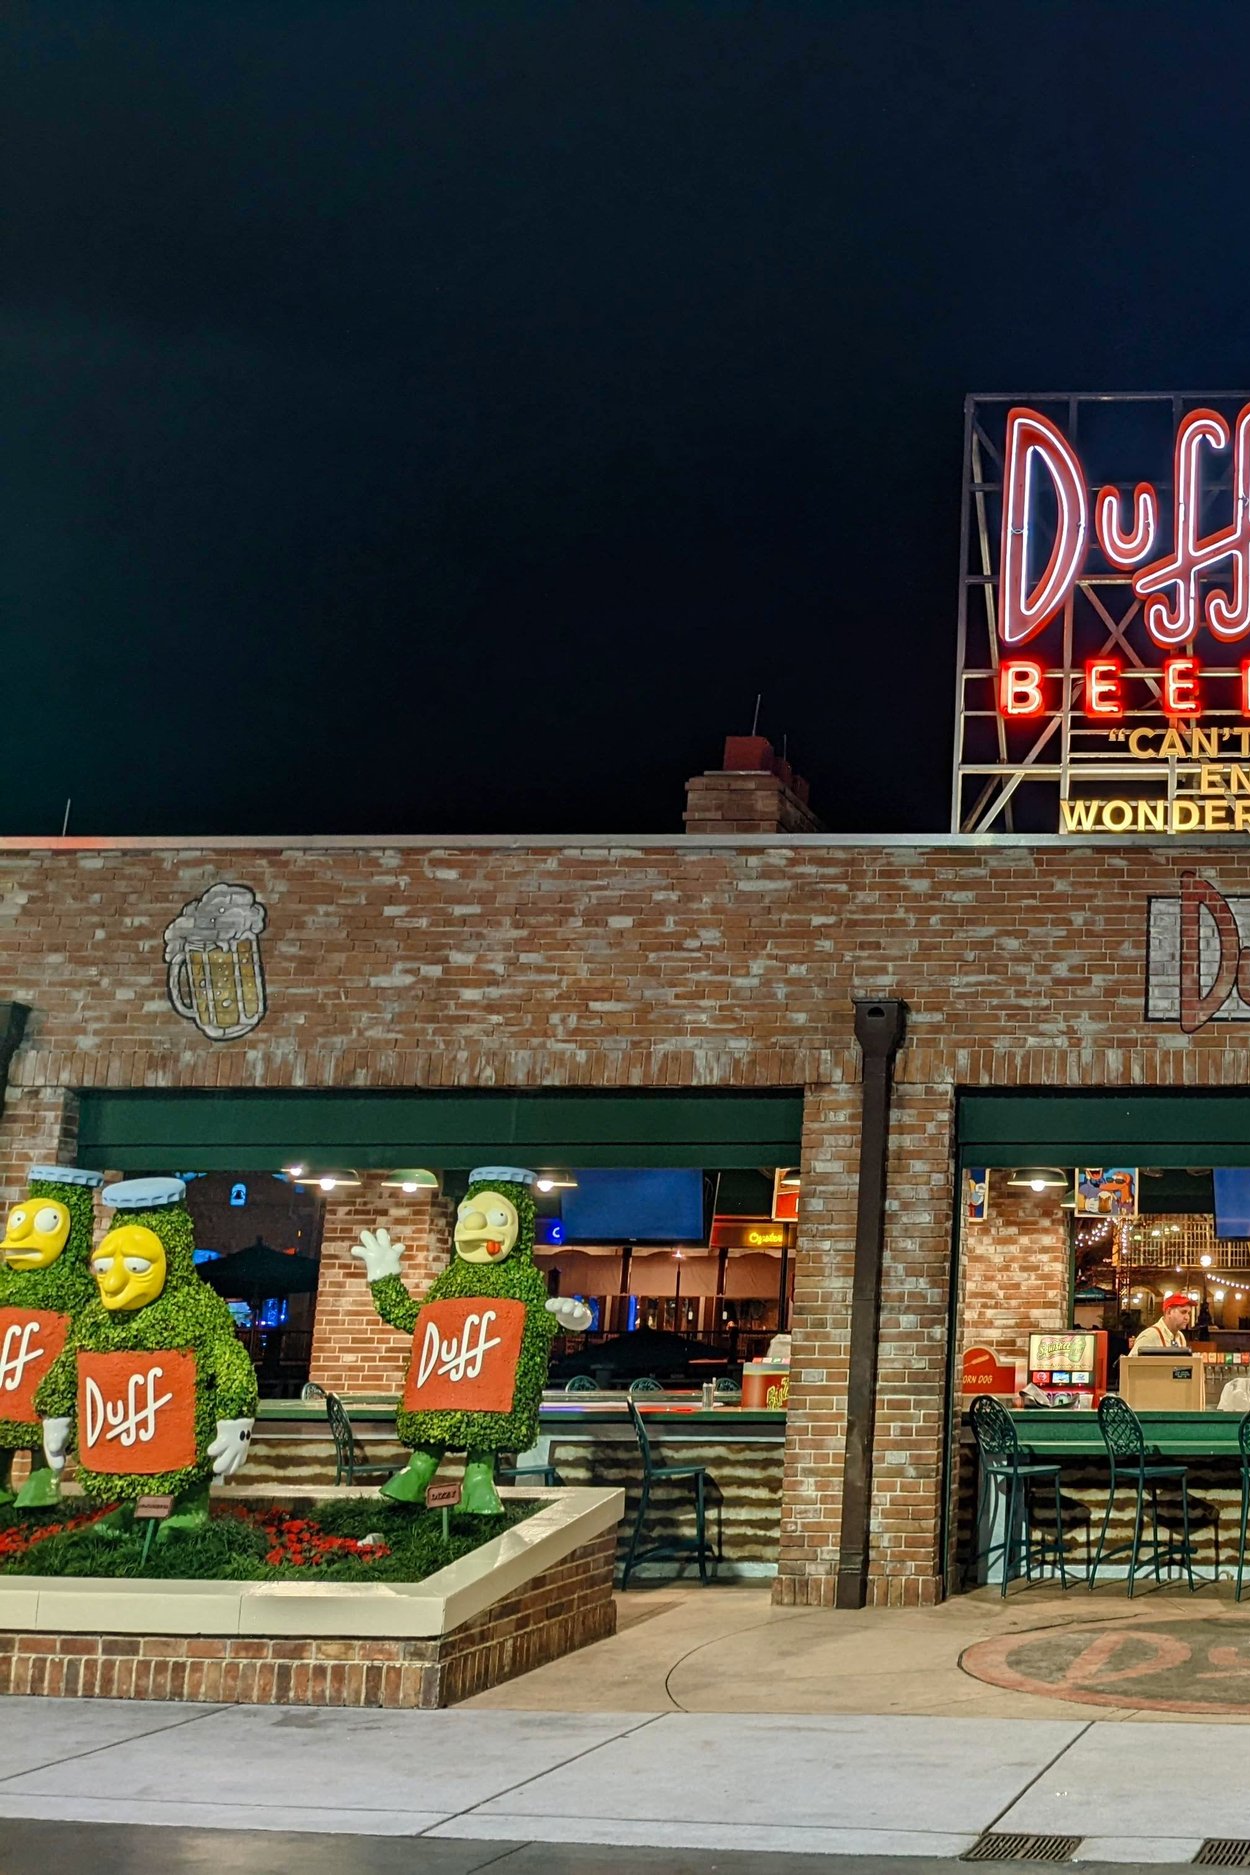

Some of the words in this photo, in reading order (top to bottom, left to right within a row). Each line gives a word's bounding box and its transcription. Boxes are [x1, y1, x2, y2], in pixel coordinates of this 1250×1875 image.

[416, 1310, 501, 1390] Duff
[963, 1375, 977, 1384] ORN
[978, 1375, 993, 1384] DOG
[85, 1366, 173, 1448] Duff
